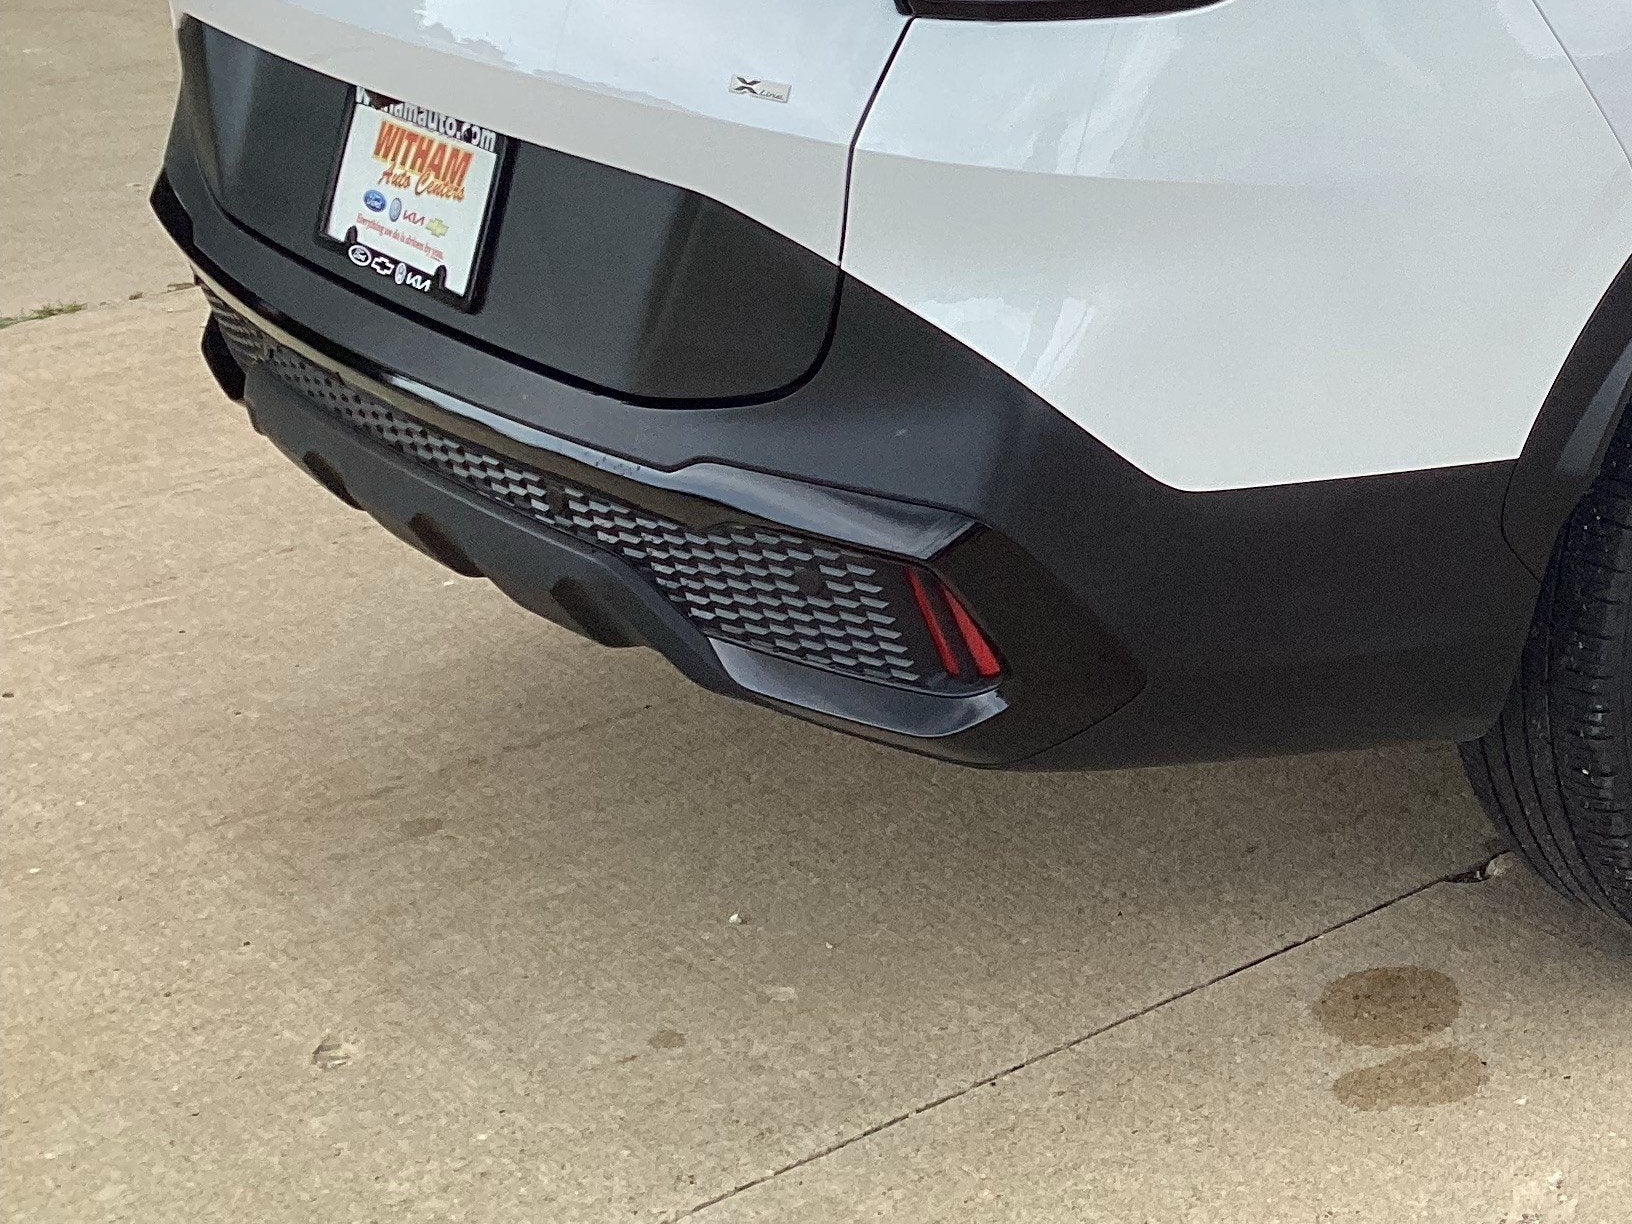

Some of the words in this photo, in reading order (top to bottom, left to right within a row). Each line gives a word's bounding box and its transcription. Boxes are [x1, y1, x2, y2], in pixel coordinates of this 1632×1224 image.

[373, 120, 475, 187] WITHAM
[378, 162, 410, 188] Auto
[405, 272, 432, 292] KIA
